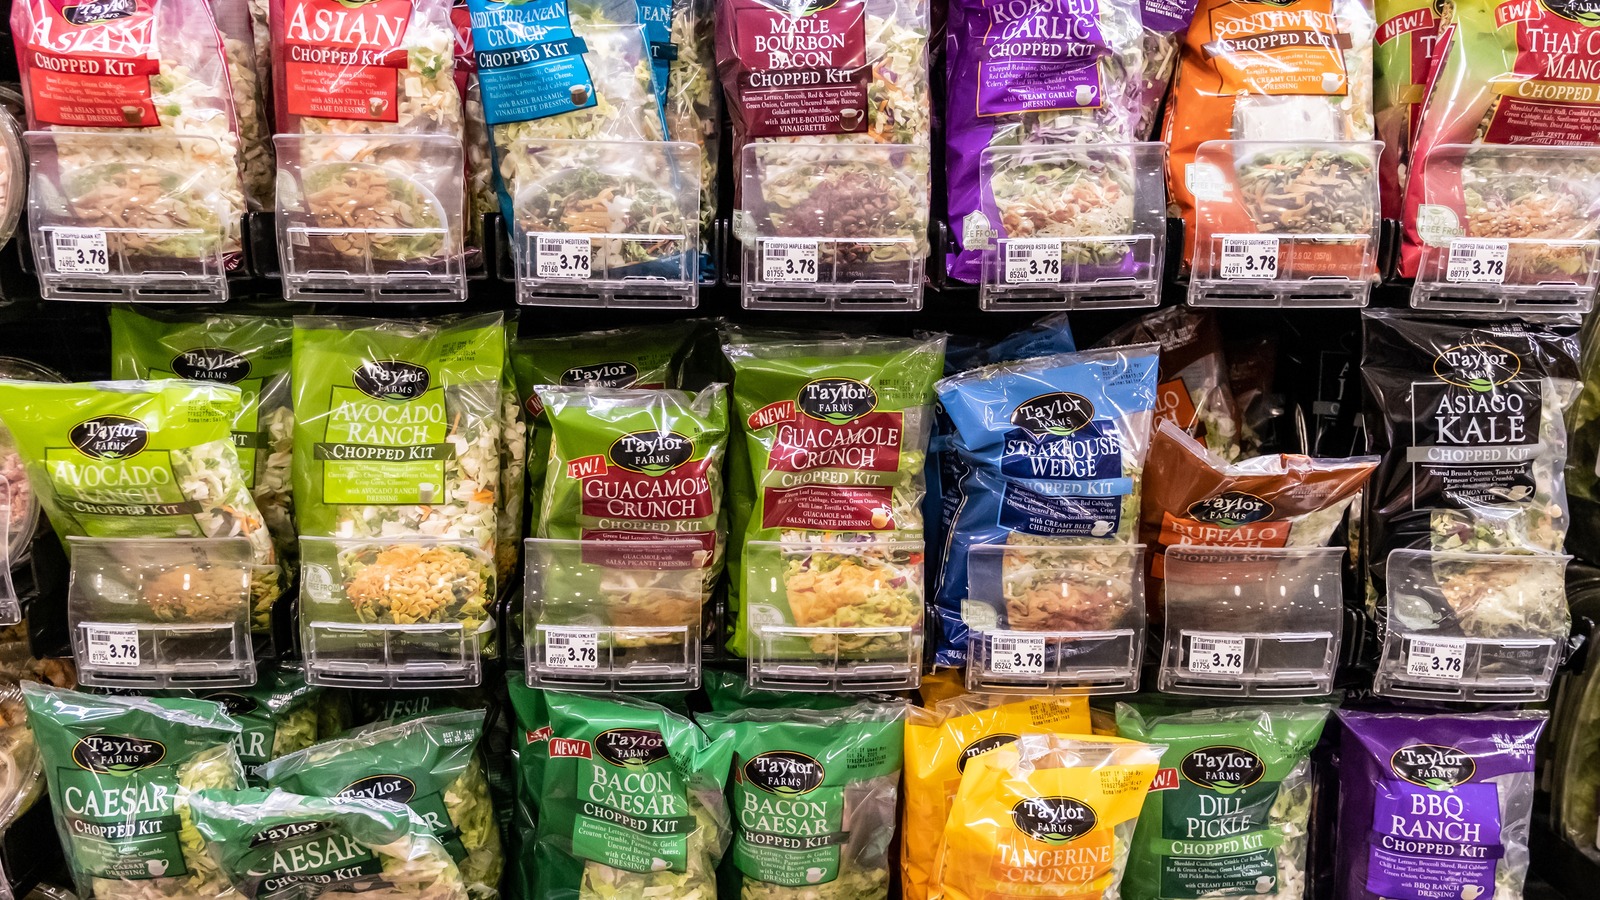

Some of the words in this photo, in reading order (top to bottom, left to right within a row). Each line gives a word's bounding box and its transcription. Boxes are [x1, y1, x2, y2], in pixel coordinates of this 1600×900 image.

[470, 2, 566, 29] MEDITERRANEAN
[993, 0, 1093, 24] ROASTED
[287, 3, 404, 46] ASIAN
[770, 18, 830, 34] MAPLE
[1001, 15, 1090, 40] GARLIC
[1384, 11, 1424, 38] NEW!
[29, 16, 158, 54] ASIAN
[755, 33, 845, 52] BOURBON
[1223, 32, 1299, 51] CHOPPED
[1303, 31, 1331, 46] KIT
[1526, 28, 1579, 54] THAI
[292, 45, 358, 64] CHOPPED
[361, 50, 387, 65] KIT
[479, 47, 540, 68] CHOPPED
[544, 42, 569, 58] KIT
[989, 43, 1062, 58] CHOPPED
[1067, 43, 1095, 57] KIT
[35, 53, 99, 73] CHOPPED
[104, 59, 135, 75] KIT
[768, 51, 833, 69] BACON
[750, 71, 820, 87] CHOPPED
[826, 68, 854, 83] KIT
[1018, 92, 1046, 101] CREAMY
[1049, 91, 1074, 99] GARLIC
[1519, 81, 1592, 101] CHOPPED
[323, 97, 343, 105] ASIAN
[345, 98, 365, 106] STYLE
[334, 105, 366, 113] DRESSING
[1023, 100, 1056, 108] DRESSING
[779, 124, 827, 132] VINAIGRETTE
[780, 115, 840, 125] MAPLE-BOURBON
[58, 259, 76, 268] 74902
[77, 249, 106, 265] 3.78
[560, 255, 589, 270] 3.78
[1245, 255, 1276, 271] 3.78
[541, 264, 559, 273] 78160
[766, 269, 784, 278] 81755
[786, 259, 816, 275] 3.78
[1009, 271, 1028, 279] 85240
[1029, 259, 1059, 275] 3.78
[1224, 266, 1243, 274] 74911
[1450, 270, 1469, 278] 88719
[1472, 260, 1503, 275] 3.78
[184, 353, 241, 371] Taylor
[1448, 352, 1508, 369] Taylor
[194, 370, 228, 379] FARMS
[369, 365, 423, 387] Taylor
[570, 365, 627, 382] Taylor
[378, 384, 413, 394] FARMS
[807, 384, 867, 404] Taylor
[332, 400, 443, 425] AVOCADO
[819, 403, 854, 412] FARMS
[1020, 399, 1081, 421] Taylor
[1436, 394, 1523, 414] ASIAGO
[757, 402, 791, 428] NEW!
[1038, 416, 1072, 428] FARMS
[84, 422, 139, 444] Taylor
[346, 422, 429, 445] RANCH
[778, 424, 898, 450] GUACAMOLE
[1435, 416, 1526, 443] KALE
[95, 441, 126, 451] FARMS
[332, 445, 405, 461] CHOPPED
[408, 445, 436, 460] KIT
[621, 436, 683, 456] Taylor
[1006, 436, 1119, 457] STEAKHOUSE
[1428, 448, 1500, 461] CHOPPED
[1505, 448, 1530, 460] KIT
[635, 454, 670, 465] FARMS
[791, 448, 875, 470] CRUNCH
[1030, 457, 1097, 478] WEDGE
[54, 462, 170, 487] AVOCADO
[781, 471, 849, 487] CHOPPED
[853, 471, 880, 485] KIT
[75, 486, 162, 503] RANCH
[361, 487, 393, 495] AVOCADO
[394, 487, 418, 495] RANCH
[585, 476, 709, 499] GUACAMOLE
[1086, 481, 1114, 495] KIT
[73, 502, 145, 515] CHOPPED
[149, 505, 179, 515] KIT
[606, 499, 696, 518] CRUNCH
[1203, 497, 1263, 513] Taylor
[803, 510, 840, 518] GUACAMOLE
[807, 517, 837, 525] PICANTE
[838, 519, 871, 527] DRESSING
[1210, 511, 1246, 520] FARMS
[598, 518, 670, 532] CHOPPED
[675, 519, 703, 532] KIT
[1044, 519, 1074, 529] CREAMY
[1171, 521, 1277, 541] BUFFALO
[1242, 553, 1269, 562] KIT
[109, 644, 137, 659] 3.78
[568, 647, 596, 662] 3.78
[1013, 653, 1043, 667] 3.78
[994, 662, 1012, 670] 85242
[1212, 653, 1242, 668] 3.78
[1431, 656, 1461, 672] 3.78
[87, 737, 153, 755] Taylor
[554, 742, 586, 756] NEW!
[607, 733, 663, 749] Taylor
[101, 754, 139, 764] FARMS
[618, 748, 649, 758] FARMS
[1193, 752, 1253, 771] Taylor
[1401, 750, 1462, 769] Taylor
[756, 757, 814, 777] Taylor
[1417, 769, 1452, 778] FARMS
[593, 764, 672, 794] BACON
[768, 777, 801, 787] FARMS
[1205, 772, 1240, 781] FARMS
[65, 785, 169, 817] CAESAR
[589, 783, 677, 816] CAESAR
[744, 791, 827, 819] BACON
[1199, 794, 1244, 816] DILL
[1410, 793, 1465, 822] BBQ
[583, 802, 647, 831] CHOPPED
[652, 819, 678, 833] KIT
[1023, 801, 1084, 823] Taylor
[74, 820, 136, 838] CHOPPED
[138, 820, 163, 834] KIT
[741, 809, 829, 835] CAESAR
[1037, 824, 1073, 833] FARMS
[1186, 815, 1252, 838] PICKLE
[1390, 814, 1481, 843] RANCH
[256, 820, 318, 842] Taylor
[745, 832, 801, 848] HOPPED
[806, 836, 831, 848] KIT
[1171, 841, 1239, 856] CHOPPED
[1241, 834, 1263, 850] KIT
[1382, 836, 1455, 856] CHOPPED
[1459, 844, 1488, 858] KIT
[620, 852, 650, 865] CAESAR
[998, 843, 1111, 867] TANGERINE
[608, 858, 645, 871] DRESSING
[265, 868, 331, 891] CHOPPED
[335, 865, 363, 881] KIT
[1007, 866, 1095, 883] CRUNCH
[1414, 881, 1431, 891] BBQ
[1432, 883, 1459, 892] RANCH
[1417, 889, 1455, 898] DRESSING
